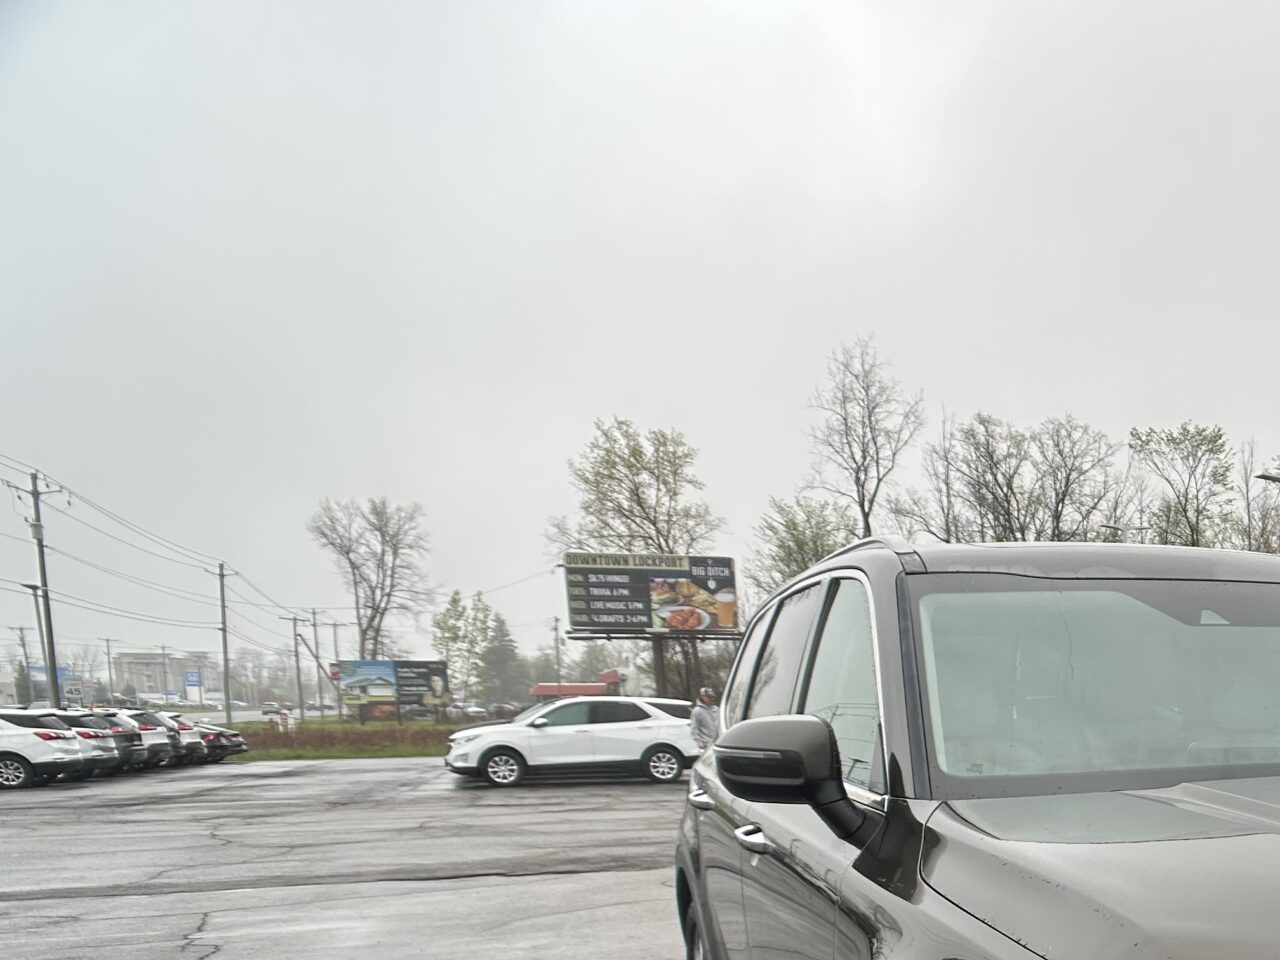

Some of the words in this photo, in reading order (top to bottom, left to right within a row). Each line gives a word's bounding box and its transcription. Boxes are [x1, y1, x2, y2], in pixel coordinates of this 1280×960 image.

[566, 553, 630, 566] DOWNTOWN
[632, 556, 684, 568] LOCKPORT
[691, 566, 705, 576] BIG
[707, 566, 730, 577] DITCH
[590, 601, 605, 609] LIVE
[605, 601, 627, 610] MUSIC
